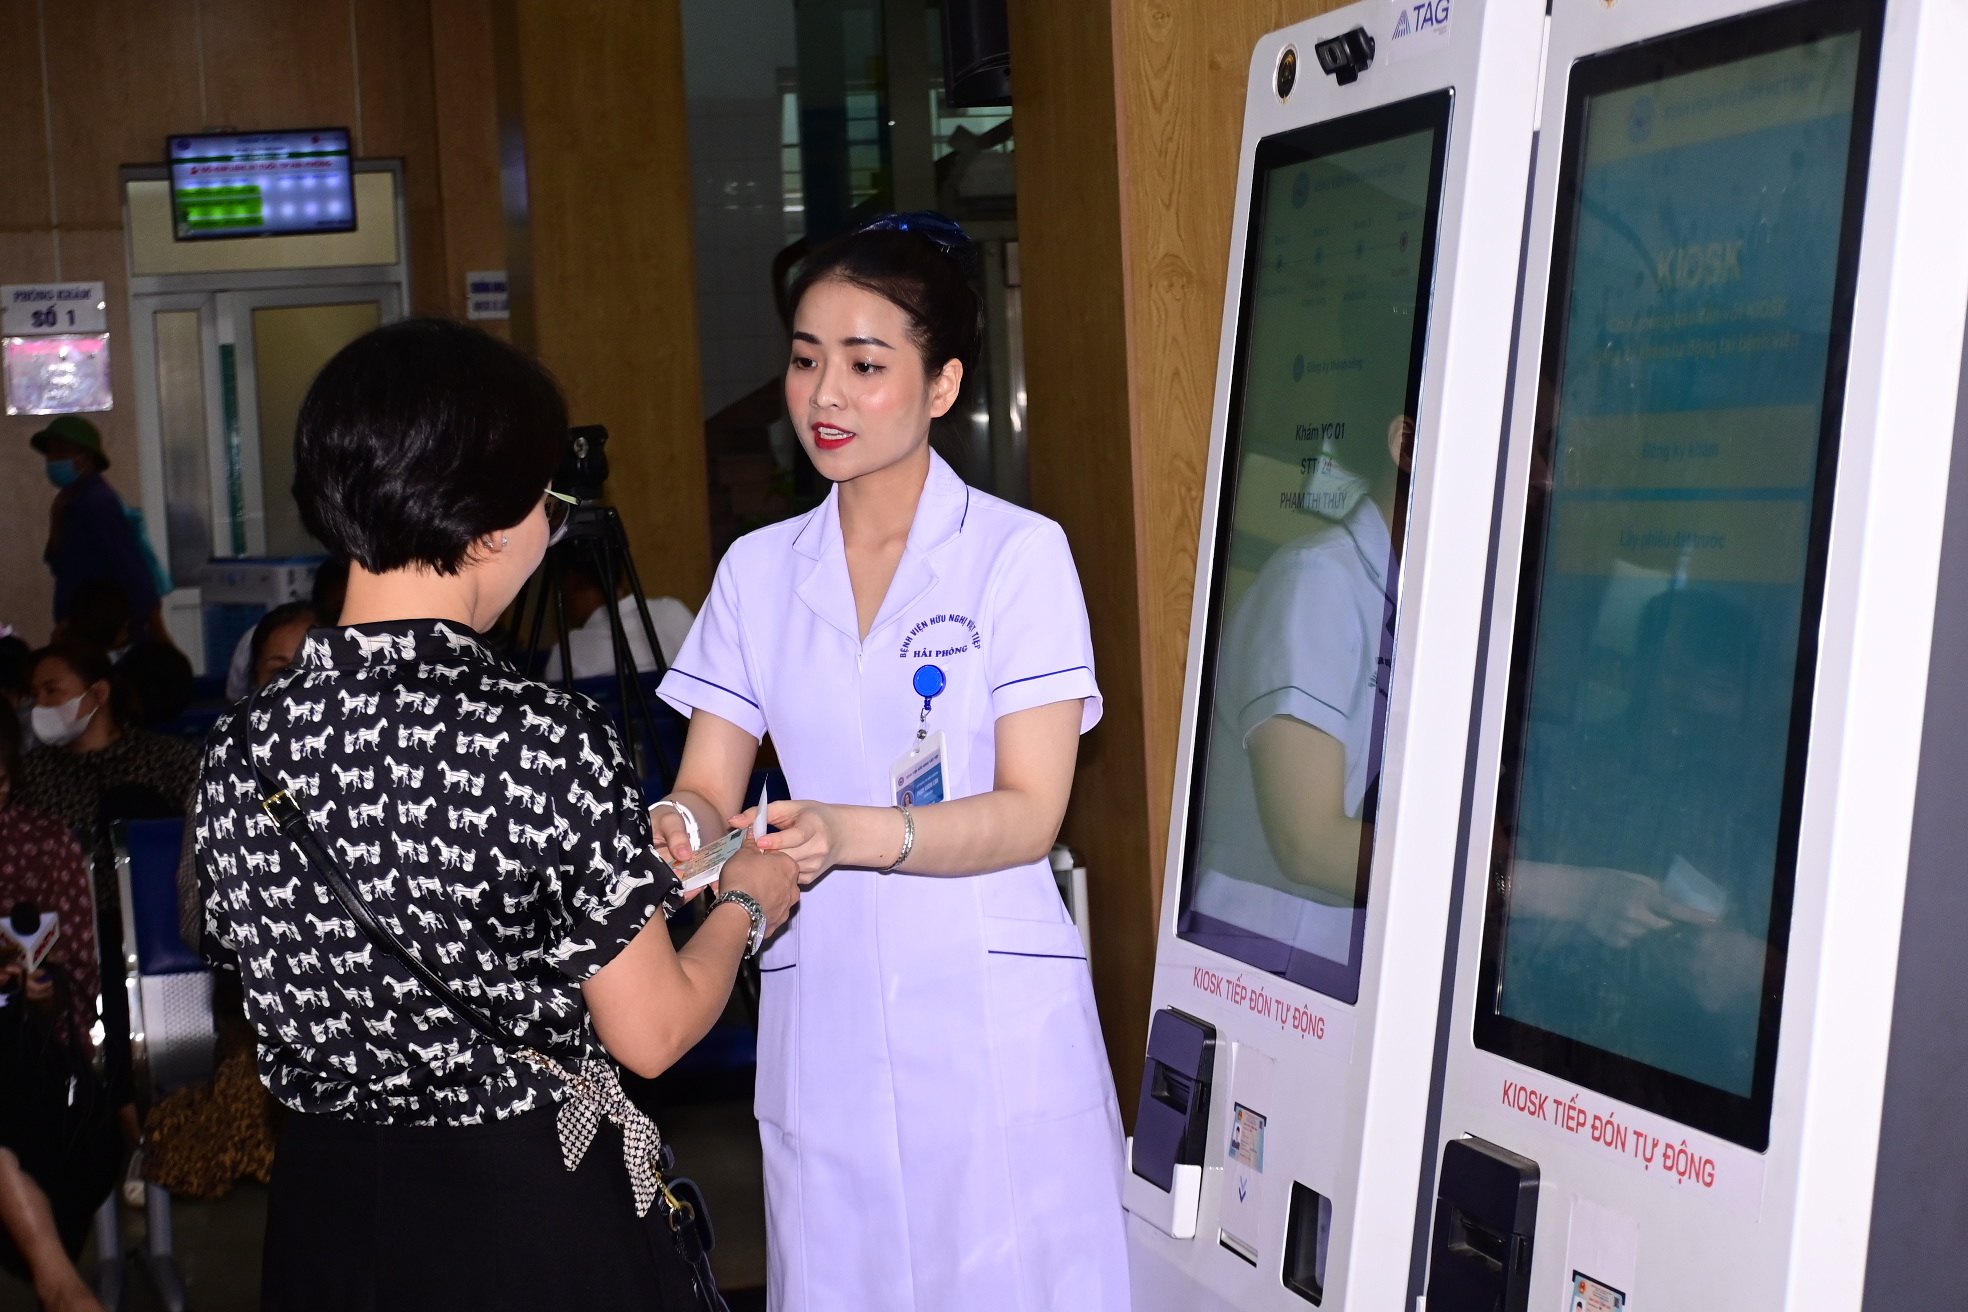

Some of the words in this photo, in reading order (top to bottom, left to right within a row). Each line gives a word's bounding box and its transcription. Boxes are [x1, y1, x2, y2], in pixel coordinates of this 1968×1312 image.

[1413, 0, 1449, 32] TAG
[1655, 240, 1744, 289] KIOSK
[31, 303, 57, 328] SỐ
[66, 309, 76, 327] 1
[1295, 423, 1319, 441] Khám
[1321, 423, 1333, 440] YC
[1334, 422, 1345, 440] 01
[1280, 492, 1305, 513] PHẠM
[1306, 492, 1321, 513] THỊ
[899, 635, 913, 658] BỆNH
[910, 620, 929, 637] VIỆN
[929, 614, 946, 625] HỮU
[948, 613, 968, 627] NGHỊ
[971, 631, 981, 650] TIỆP
[913, 647, 932, 658] HẢI
[935, 645, 967, 658] PHÒNG
[1193, 966, 1223, 998] KIOSK
[1226, 973, 1248, 1006] TIẾP
[1249, 986, 1272, 1018] ĐÓN
[1275, 999, 1291, 1030] TỰ
[1292, 1003, 1325, 1040] ĐỘNG
[1502, 1079, 1549, 1121] KIOSK
[1552, 1093, 1587, 1134] TIẾP
[1591, 1112, 1628, 1153] ĐÓN
[1633, 1129, 1659, 1171] TỰ
[1662, 1139, 1716, 1188] ĐỘNG
